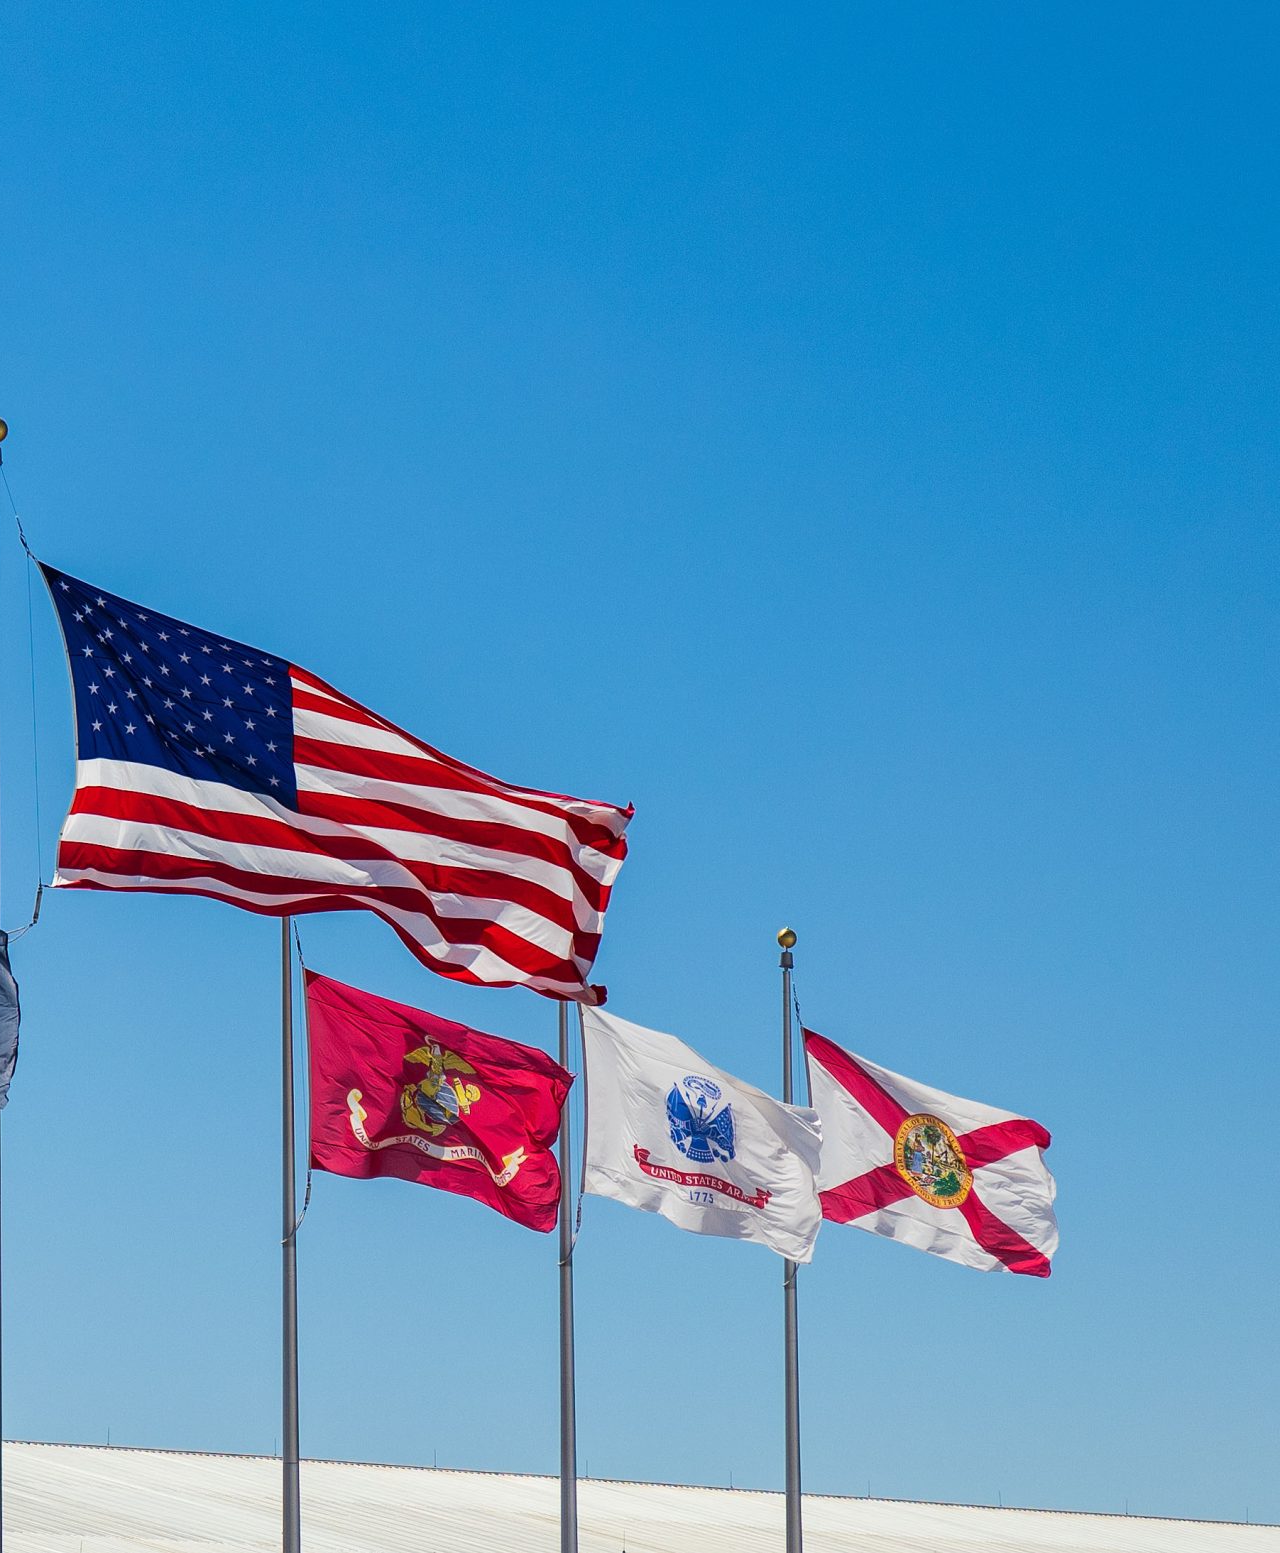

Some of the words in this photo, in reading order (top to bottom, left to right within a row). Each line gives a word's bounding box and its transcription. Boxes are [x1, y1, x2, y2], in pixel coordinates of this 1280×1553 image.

[394, 1136, 431, 1152] STATES
[650, 1166, 682, 1183] UNITED
[685, 1175, 723, 1190] STATES
[689, 1190, 714, 1204] 1775
